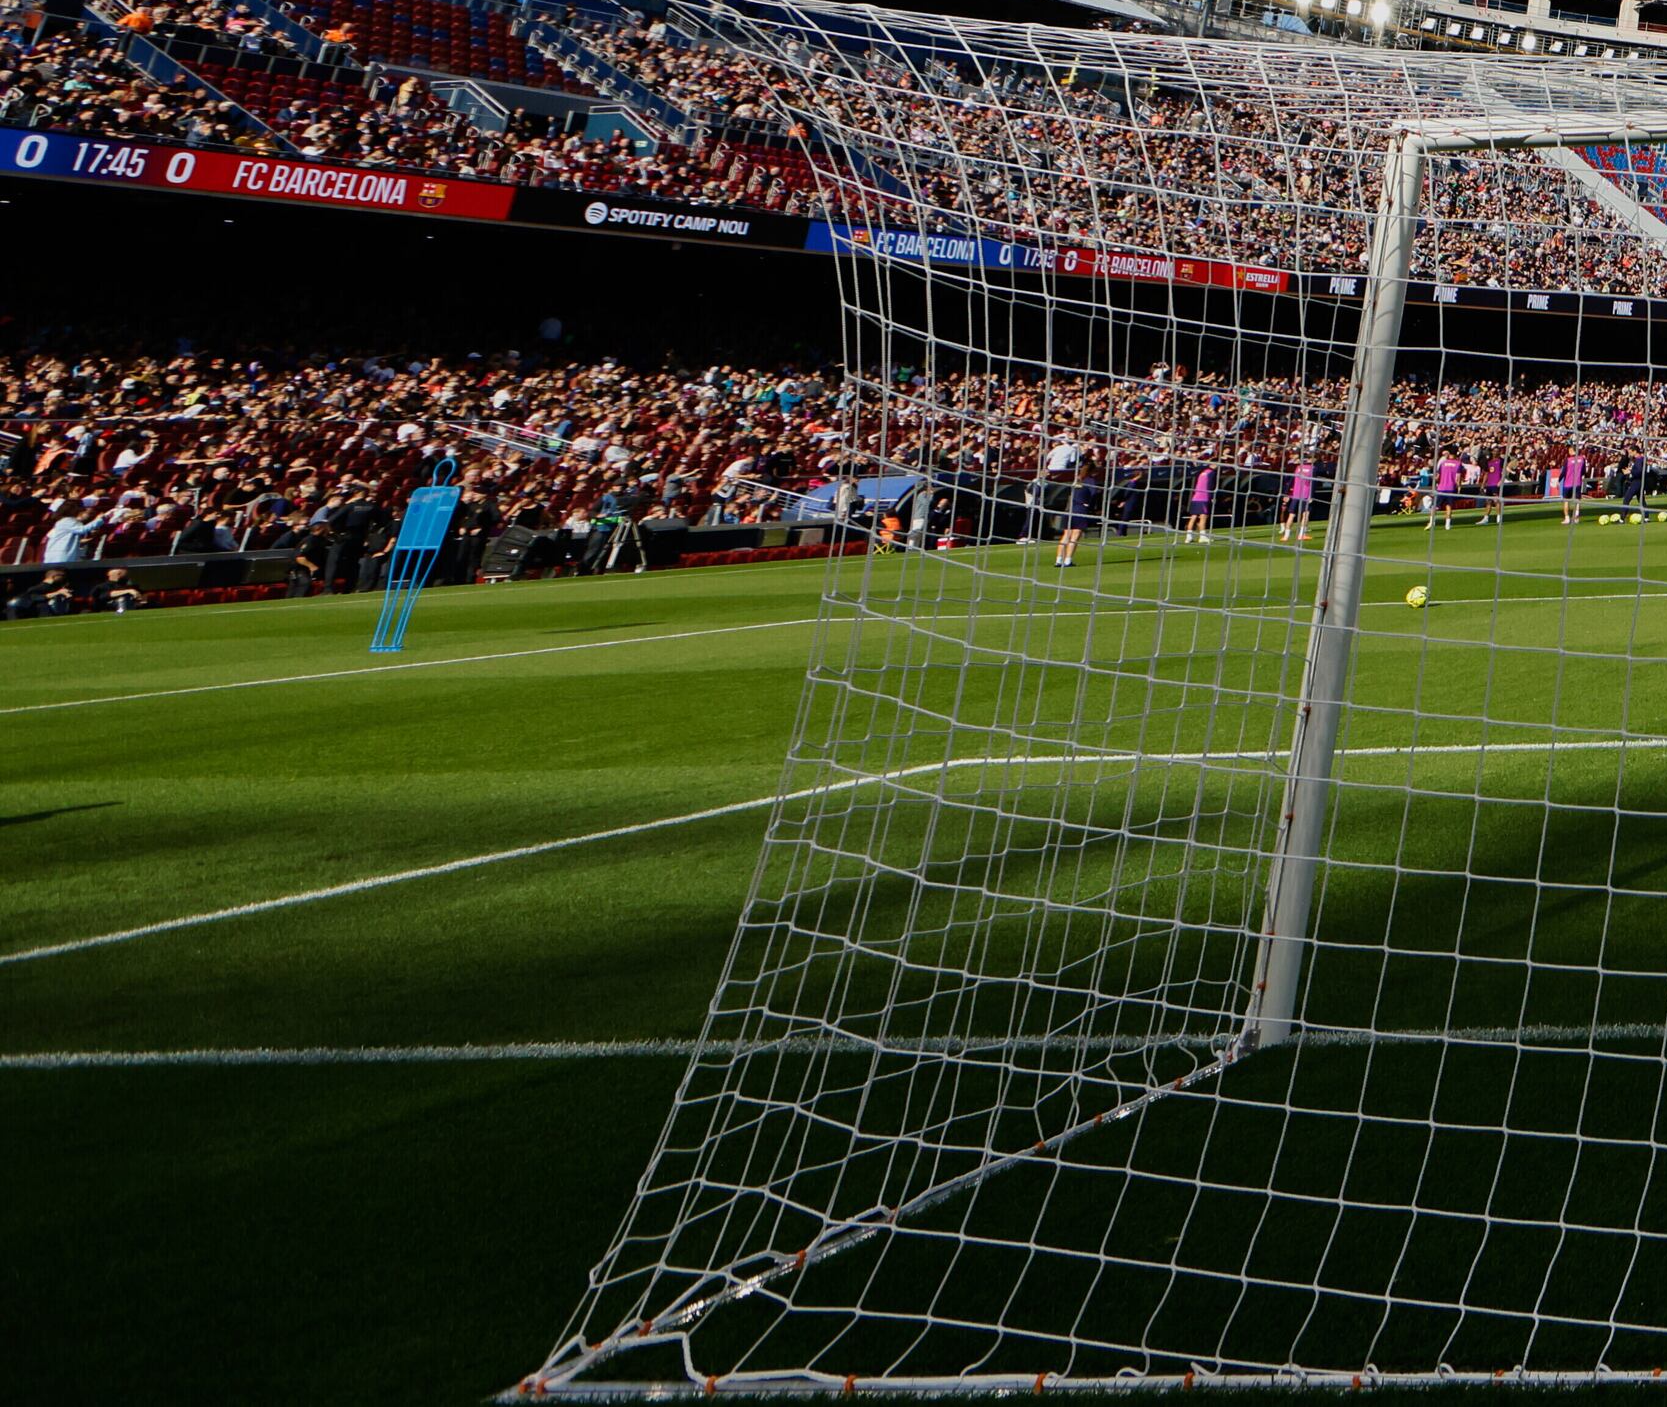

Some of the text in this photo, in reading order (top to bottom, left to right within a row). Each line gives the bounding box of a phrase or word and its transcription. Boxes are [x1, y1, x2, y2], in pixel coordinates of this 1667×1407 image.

[15, 135, 408, 205] 0 17:45 0 FC BARCELONA
[608, 207, 749, 235] SPOTIFY CAMP NOU
[876, 232, 895, 253] FC
[895, 233, 975, 261] BARCELONA
[999, 244, 1013, 265] 0
[1064, 250, 1078, 272] 0
[1527, 294, 1550, 311] PRIME
[1612, 301, 1633, 316] PRIME
